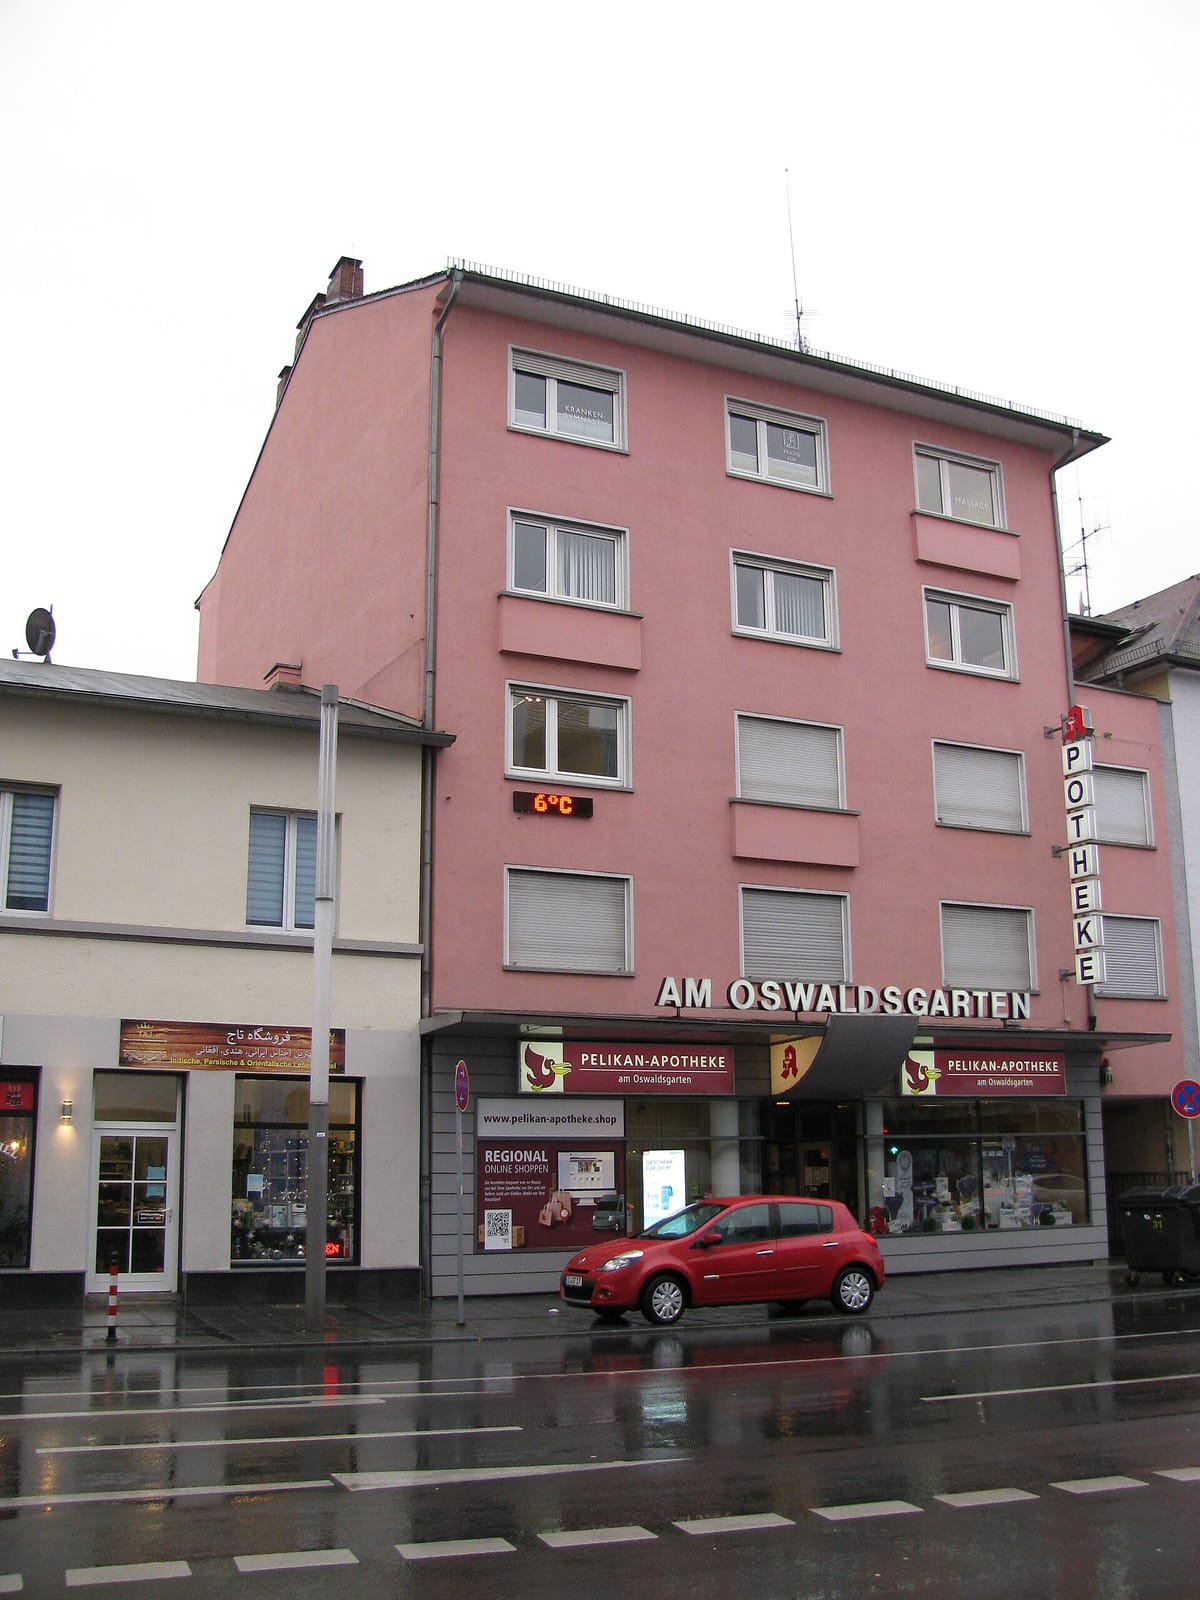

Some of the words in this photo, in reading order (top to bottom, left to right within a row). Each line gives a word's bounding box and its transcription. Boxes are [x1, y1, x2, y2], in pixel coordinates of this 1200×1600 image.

[655, 975, 712, 1009] AM
[727, 978, 1031, 1020] OSWALDSGARTEN
[226, 1028, 245, 1045] تاج
[580, 1052, 726, 1069] PELIKAN-APOTHEKE
[947, 1059, 1059, 1073] PELIKAN-APOTHEKE
[617, 1075, 631, 1084] am
[632, 1073, 692, 1086] Oswaldsgarten
[976, 1078, 988, 1087] am
[988, 1077, 1034, 1089] Oswaldsgarten
[483, 1113, 618, 1126] www.pelikan-apotheke.shop
[484, 1149, 549, 1163] REGIONAL
[484, 1164, 513, 1174] ONLINE
[513, 1164, 549, 1174] SHOPPEN
